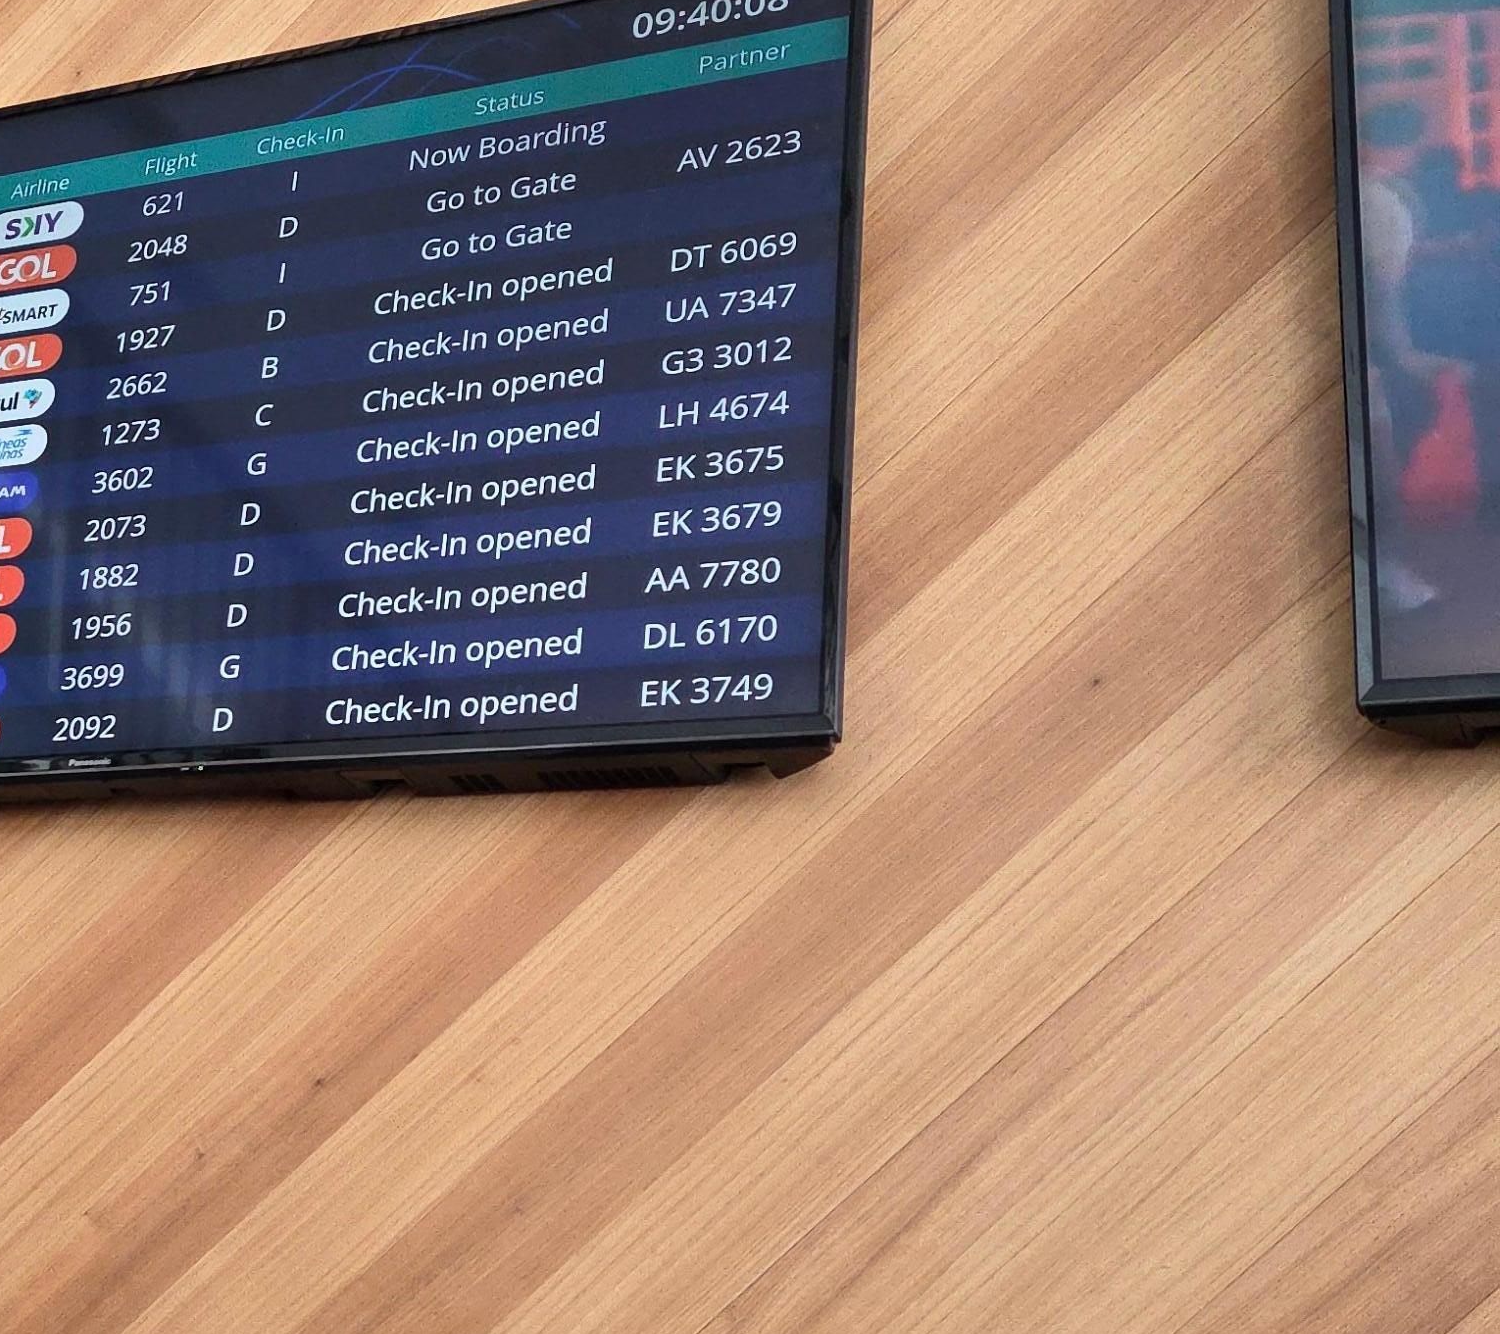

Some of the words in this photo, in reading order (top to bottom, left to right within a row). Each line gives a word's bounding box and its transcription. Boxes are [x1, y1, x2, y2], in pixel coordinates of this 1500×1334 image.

[10, 178, 70, 200] Airline
[145, 152, 198, 180] Flight
[257, 127, 344, 155] Check-In
[475, 91, 544, 115] Status
[699, 44, 790, 74] Partner
[142, 191, 183, 217] 621
[291, 171, 298, 192] I
[409, 144, 471, 171] Now
[478, 120, 607, 159] Boarding
[127, 234, 188, 263] 2048
[279, 216, 299, 238] D
[427, 191, 465, 213] Go
[473, 185, 498, 206] to
[510, 172, 576, 199] Gate
[676, 144, 718, 173] AV
[725, 130, 801, 164] 2623
[117, 324, 176, 353] 1927
[267, 309, 286, 332] D
[374, 280, 492, 315] Check-In
[501, 257, 613, 302] opened
[670, 244, 713, 272] DT
[720, 231, 797, 264] 6069
[130, 280, 170, 306] 751
[279, 262, 286, 284] I
[421, 238, 460, 261] Go
[468, 233, 494, 254] to
[505, 221, 572, 247] Gate
[106, 371, 167, 400] 2662
[261, 356, 279, 379] B
[368, 329, 487, 364] Check-In
[497, 307, 609, 352] opened
[666, 296, 709, 323] UA
[719, 283, 797, 316] 7347
[102, 418, 161, 446] 1273
[255, 403, 274, 427] C
[362, 379, 482, 413] Check-In
[492, 359, 605, 403] opened
[662, 348, 704, 375] G3
[713, 336, 792, 369] 3012
[91, 466, 154, 494] 3602
[247, 452, 267, 476] G
[356, 429, 477, 463] Check-In
[486, 410, 601, 454] opened
[659, 400, 699, 429] LH
[709, 390, 790, 422] 4674
[83, 514, 147, 543] 2073
[240, 502, 261, 526] D
[350, 481, 472, 514] Check-In
[481, 463, 596, 507] opened
[656, 454, 697, 483] EK
[704, 445, 784, 477] 3675
[80, 563, 139, 590] 1882
[233, 552, 254, 577] D
[344, 533, 467, 566] Check-In
[476, 517, 592, 560] opened
[652, 509, 693, 538] EK
[700, 500, 782, 533] 3679
[72, 612, 132, 640] 1956
[226, 603, 248, 628] D
[338, 586, 462, 618] Check-In
[471, 571, 588, 614] opened
[644, 565, 690, 593] AA
[699, 557, 781, 588] 7780
[60, 663, 125, 691] 3699
[219, 654, 241, 679] G
[331, 640, 457, 671] Check-In
[465, 627, 583, 669] opened
[643, 622, 686, 649] DL
[696, 614, 778, 645] 6170
[52, 714, 116, 742] 2092
[212, 707, 234, 732] D
[325, 694, 451, 725] Check-In
[460, 683, 578, 725] opened
[640, 679, 682, 707] EK
[691, 673, 773, 704] 3749
